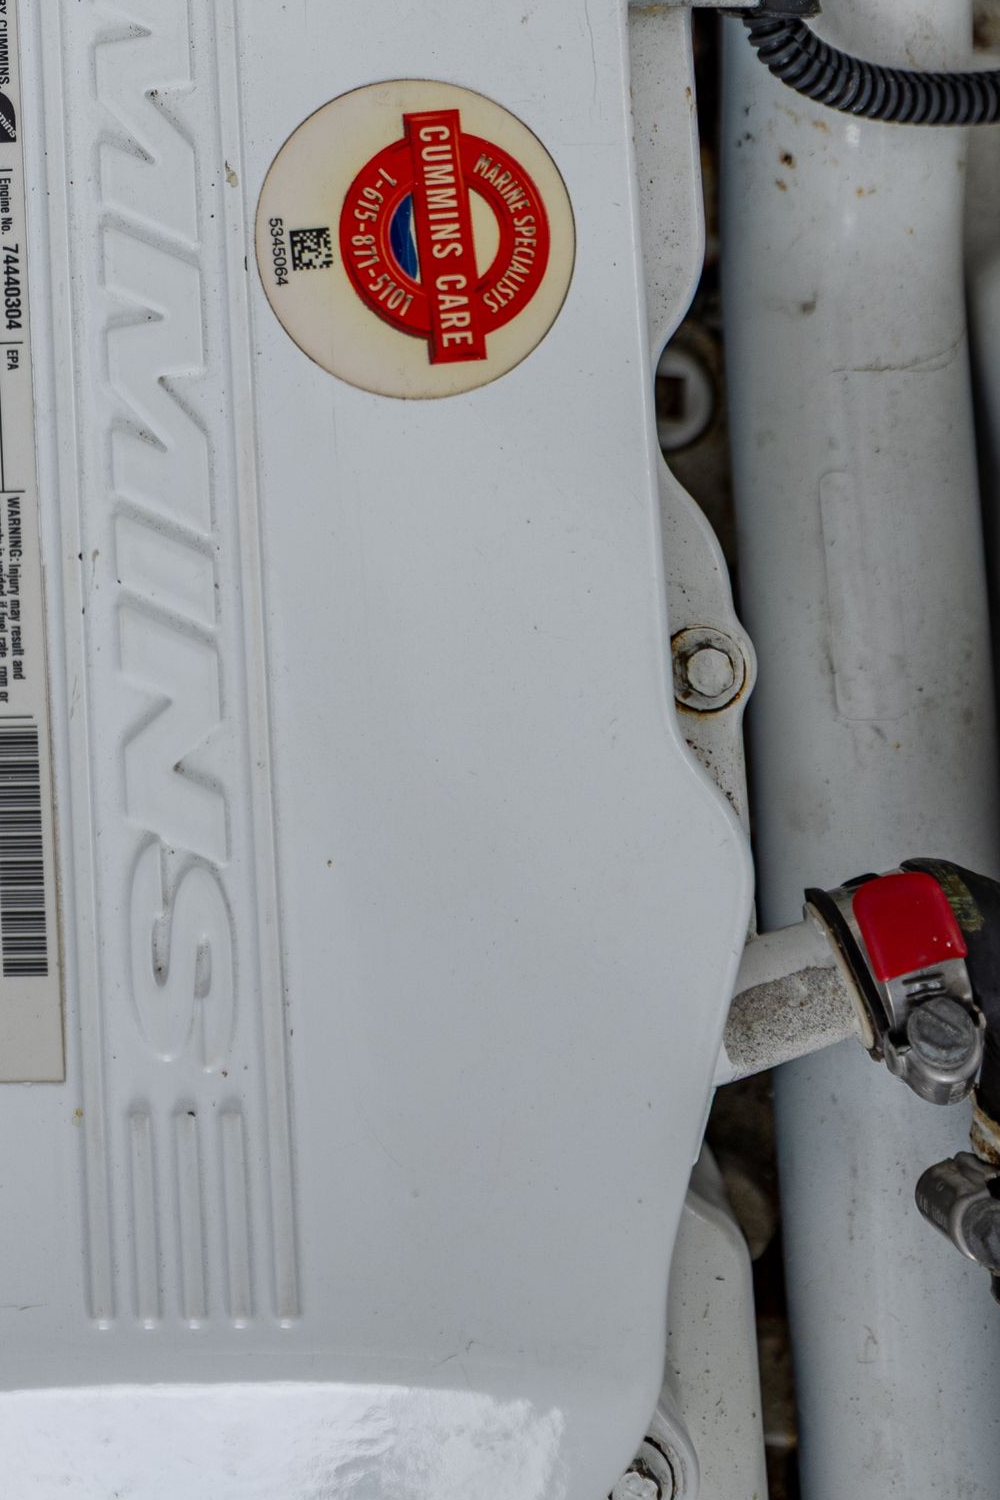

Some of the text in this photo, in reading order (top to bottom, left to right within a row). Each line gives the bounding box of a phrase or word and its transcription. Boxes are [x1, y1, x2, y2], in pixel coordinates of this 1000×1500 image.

[0, 217, 12, 234] No.
[268, 217, 289, 287] 5345064
[351, 167, 415, 316] 1-615-871-5101
[418, 124, 473, 348] CUMMINS CARE
[473, 153, 537, 313] MARINE SPECIALISTS
[2, 243, 22, 330] 74440304
[6, 349, 18, 370] EPA
[4, 496, 25, 679] WARNING: Injury may result and
